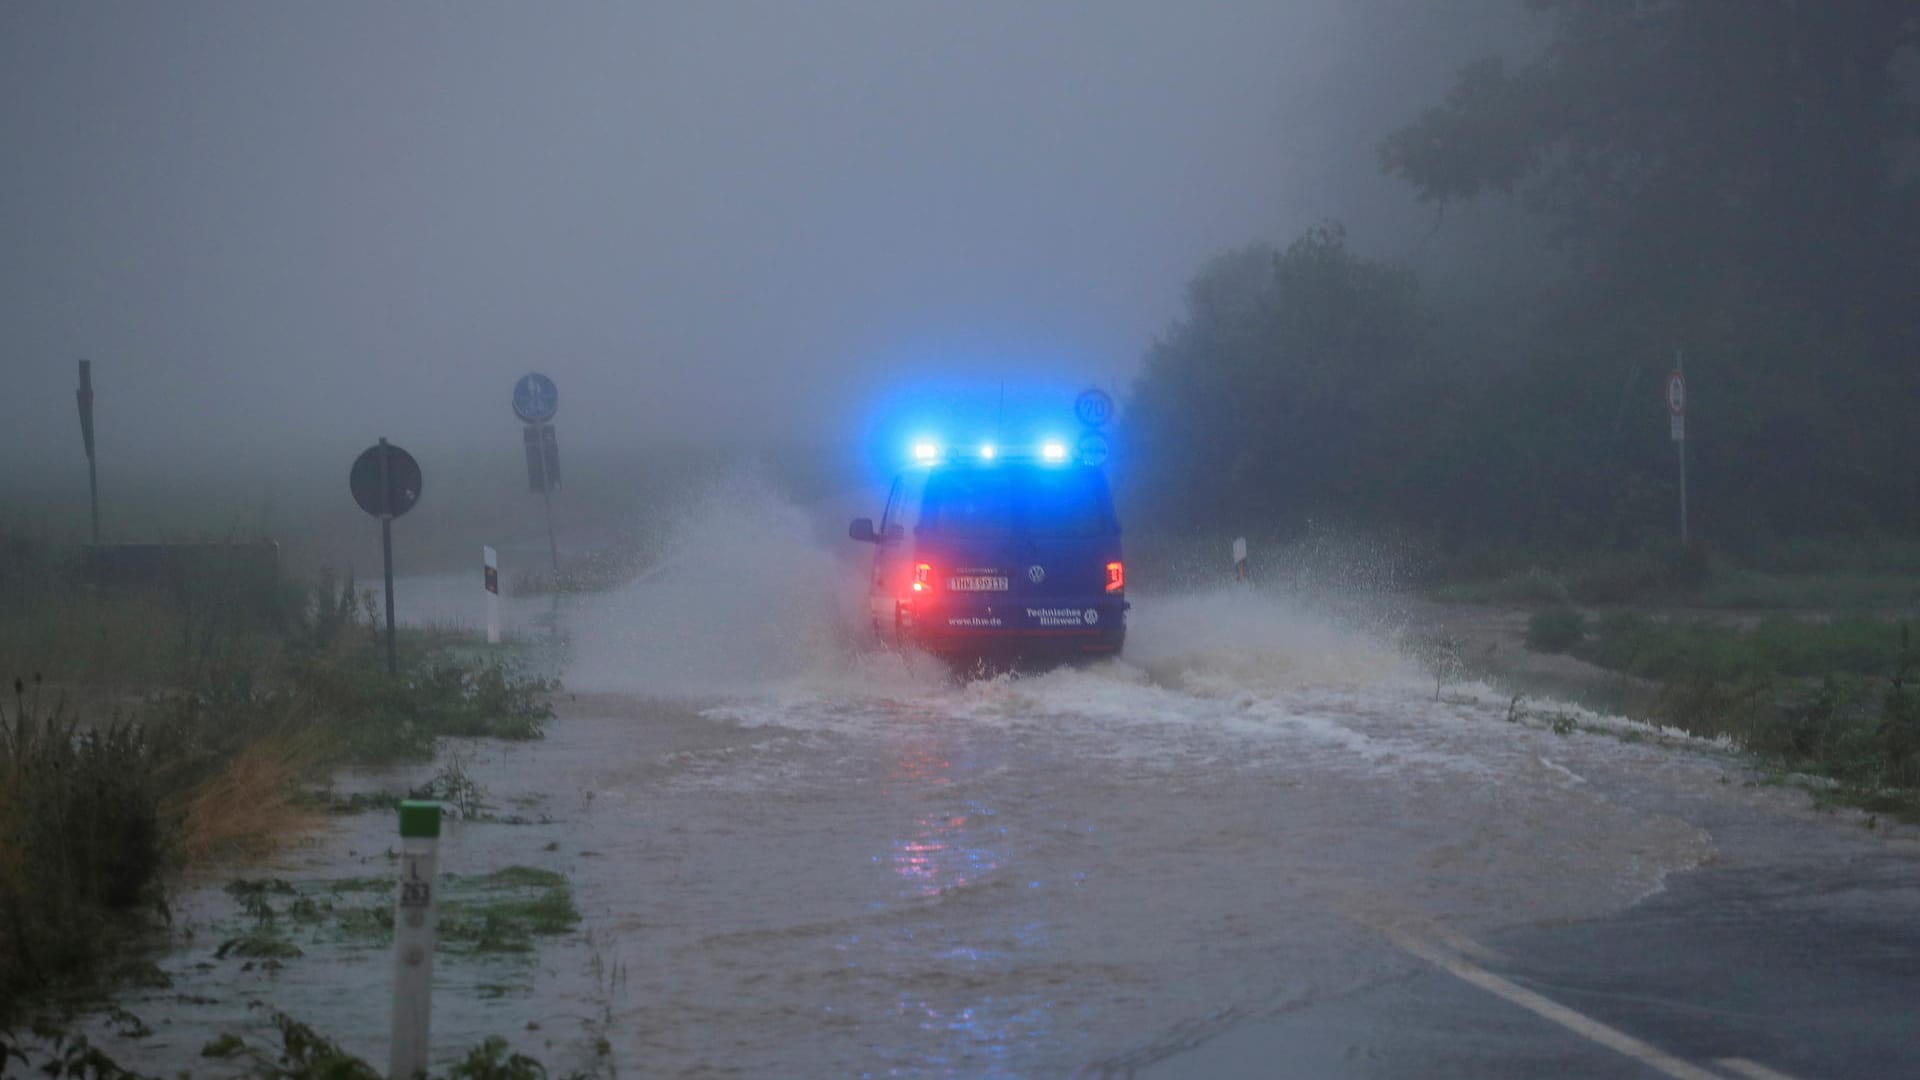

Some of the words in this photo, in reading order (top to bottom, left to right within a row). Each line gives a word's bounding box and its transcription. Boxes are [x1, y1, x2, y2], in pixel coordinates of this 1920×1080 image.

[1081, 399, 1105, 420] 70
[1026, 608, 1081, 617] Technisches
[1040, 617, 1081, 625] Hilfswerk
